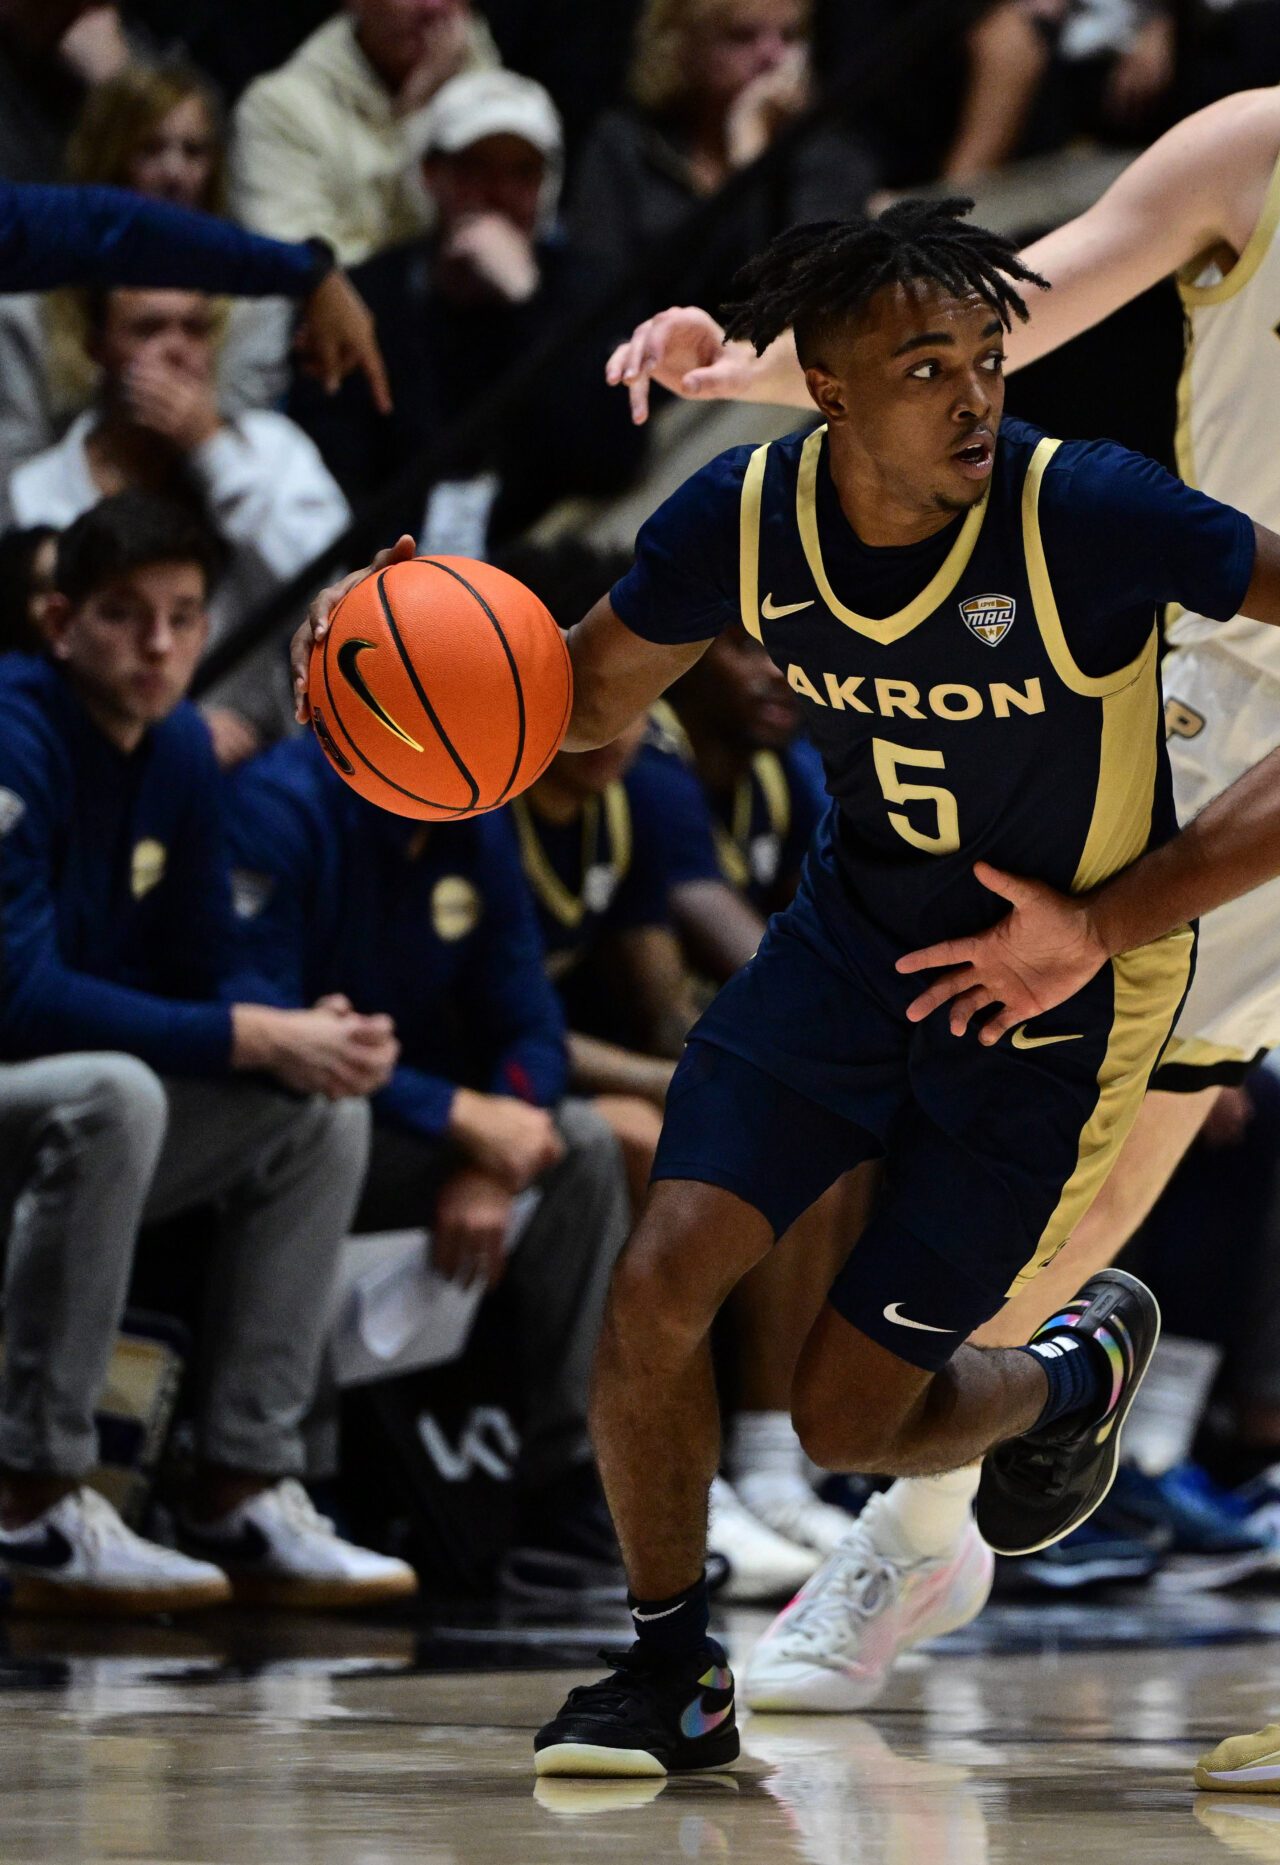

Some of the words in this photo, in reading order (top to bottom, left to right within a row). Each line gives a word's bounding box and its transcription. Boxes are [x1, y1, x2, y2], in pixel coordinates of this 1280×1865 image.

[966, 609, 1012, 627] MAC
[787, 663, 1046, 721] AKRON
[872, 736, 961, 856] 5
